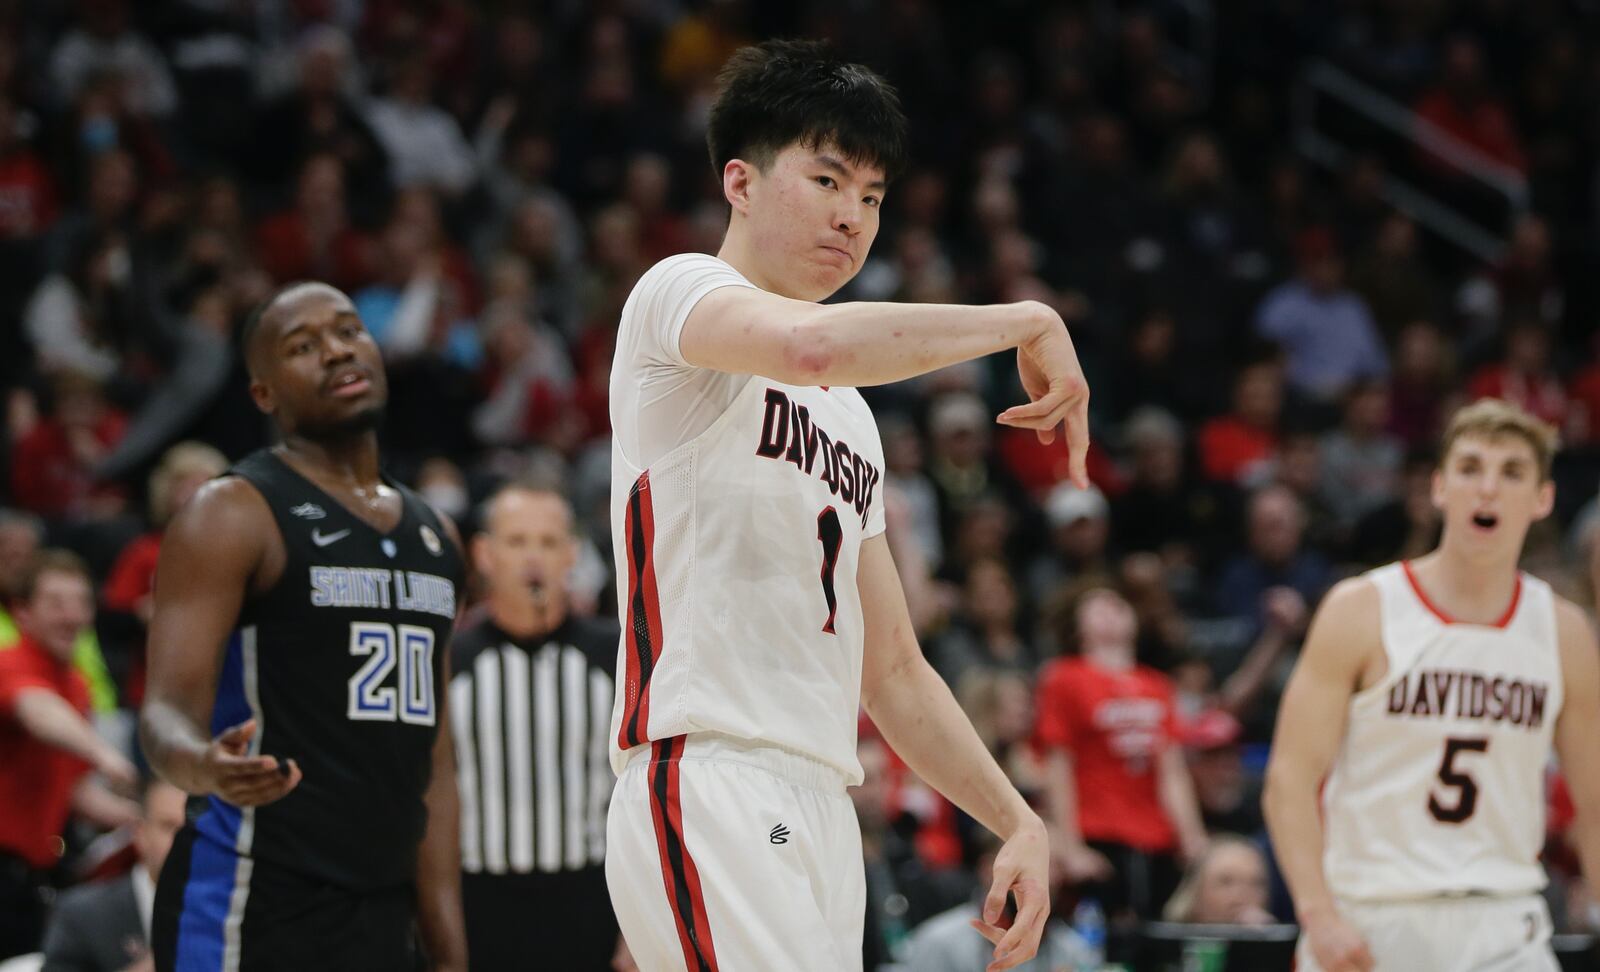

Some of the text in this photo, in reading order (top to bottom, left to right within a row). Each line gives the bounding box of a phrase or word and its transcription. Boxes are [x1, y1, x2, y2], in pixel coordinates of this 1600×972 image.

[756, 388, 879, 530] DAVDSON
[309, 566, 456, 619] SAINT LOUIS
[818, 505, 843, 635] 1
[347, 621, 436, 727] 20
[1386, 670, 1548, 730] DAVIDSON
[1427, 735, 1489, 825] 5
